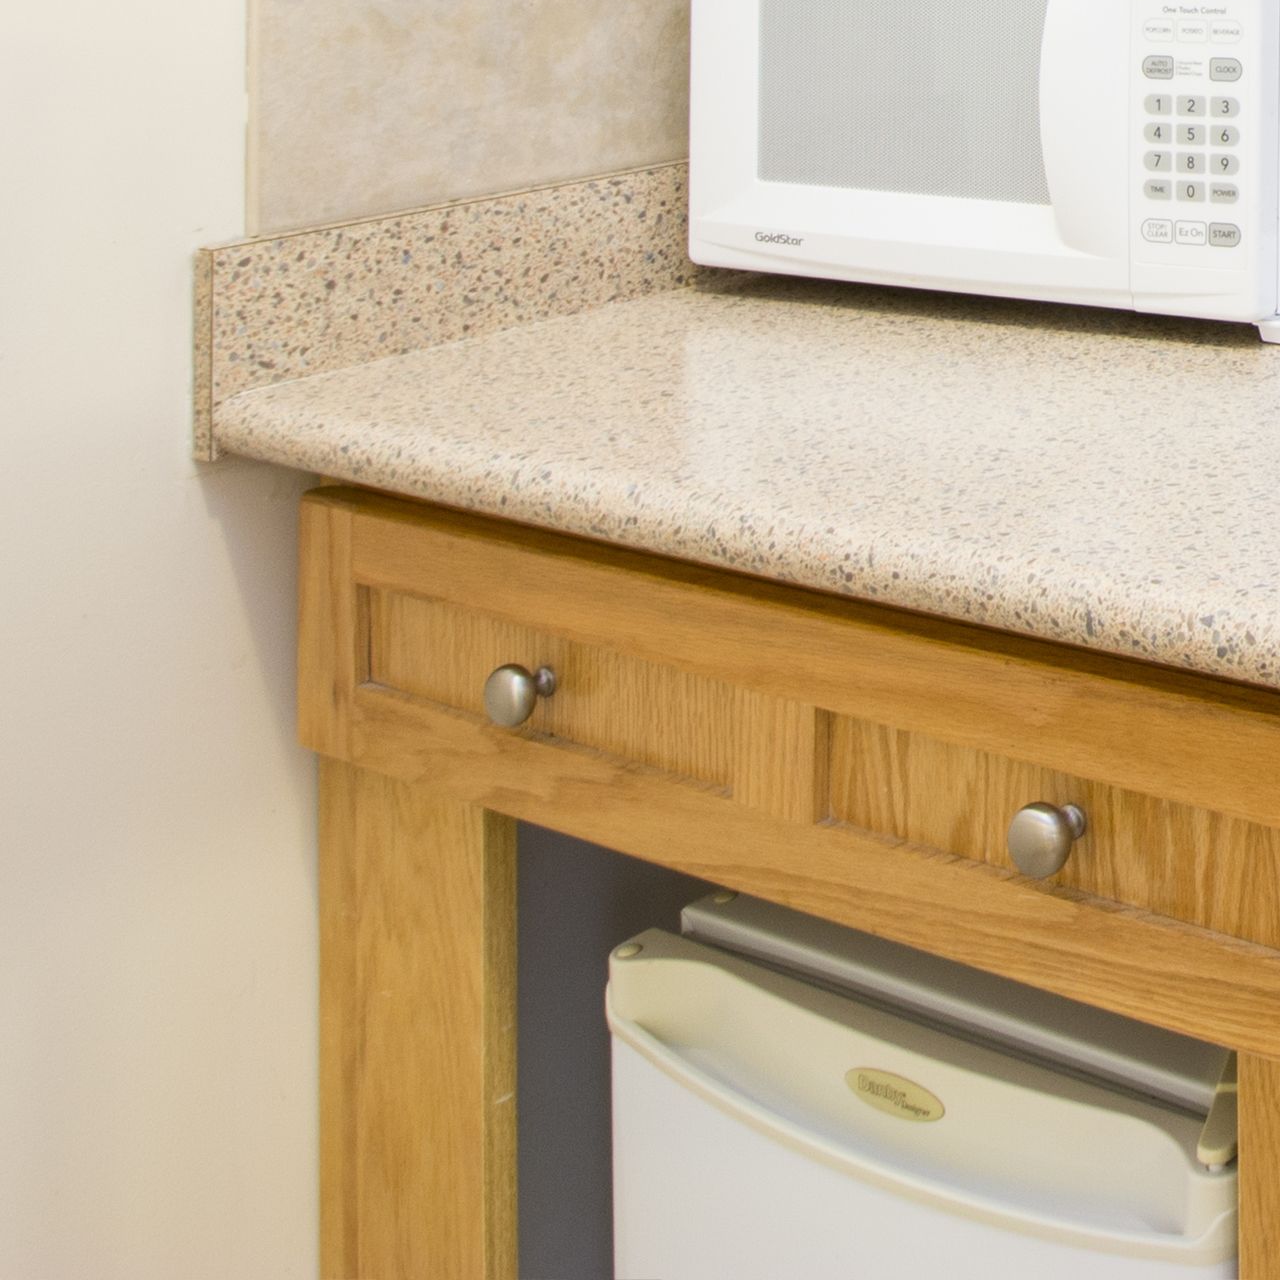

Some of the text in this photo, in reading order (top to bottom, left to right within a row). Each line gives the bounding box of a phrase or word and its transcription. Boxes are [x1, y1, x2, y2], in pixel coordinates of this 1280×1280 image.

[1179, 6, 1198, 14] Touch
[1155, 98, 1162, 112] 1
[1186, 99, 1196, 113] 2
[1221, 100, 1230, 115] 3
[1153, 126, 1162, 139] 4
[1186, 127, 1196, 141] 5
[1220, 129, 1230, 143] 6
[1153, 154, 1162, 168] 7
[1186, 156, 1196, 170] 8
[1220, 157, 1230, 171] 9
[1150, 185, 1165, 193] TIME
[1186, 184, 1196, 199] 0
[1212, 189, 1236, 197] POWER
[755, 231, 804, 246] GoldStar
[1147, 230, 1168, 238] CLEAR
[1178, 227, 1204, 238] Ez On
[1212, 230, 1236, 239] START
[858, 1074, 906, 1106] Danby
